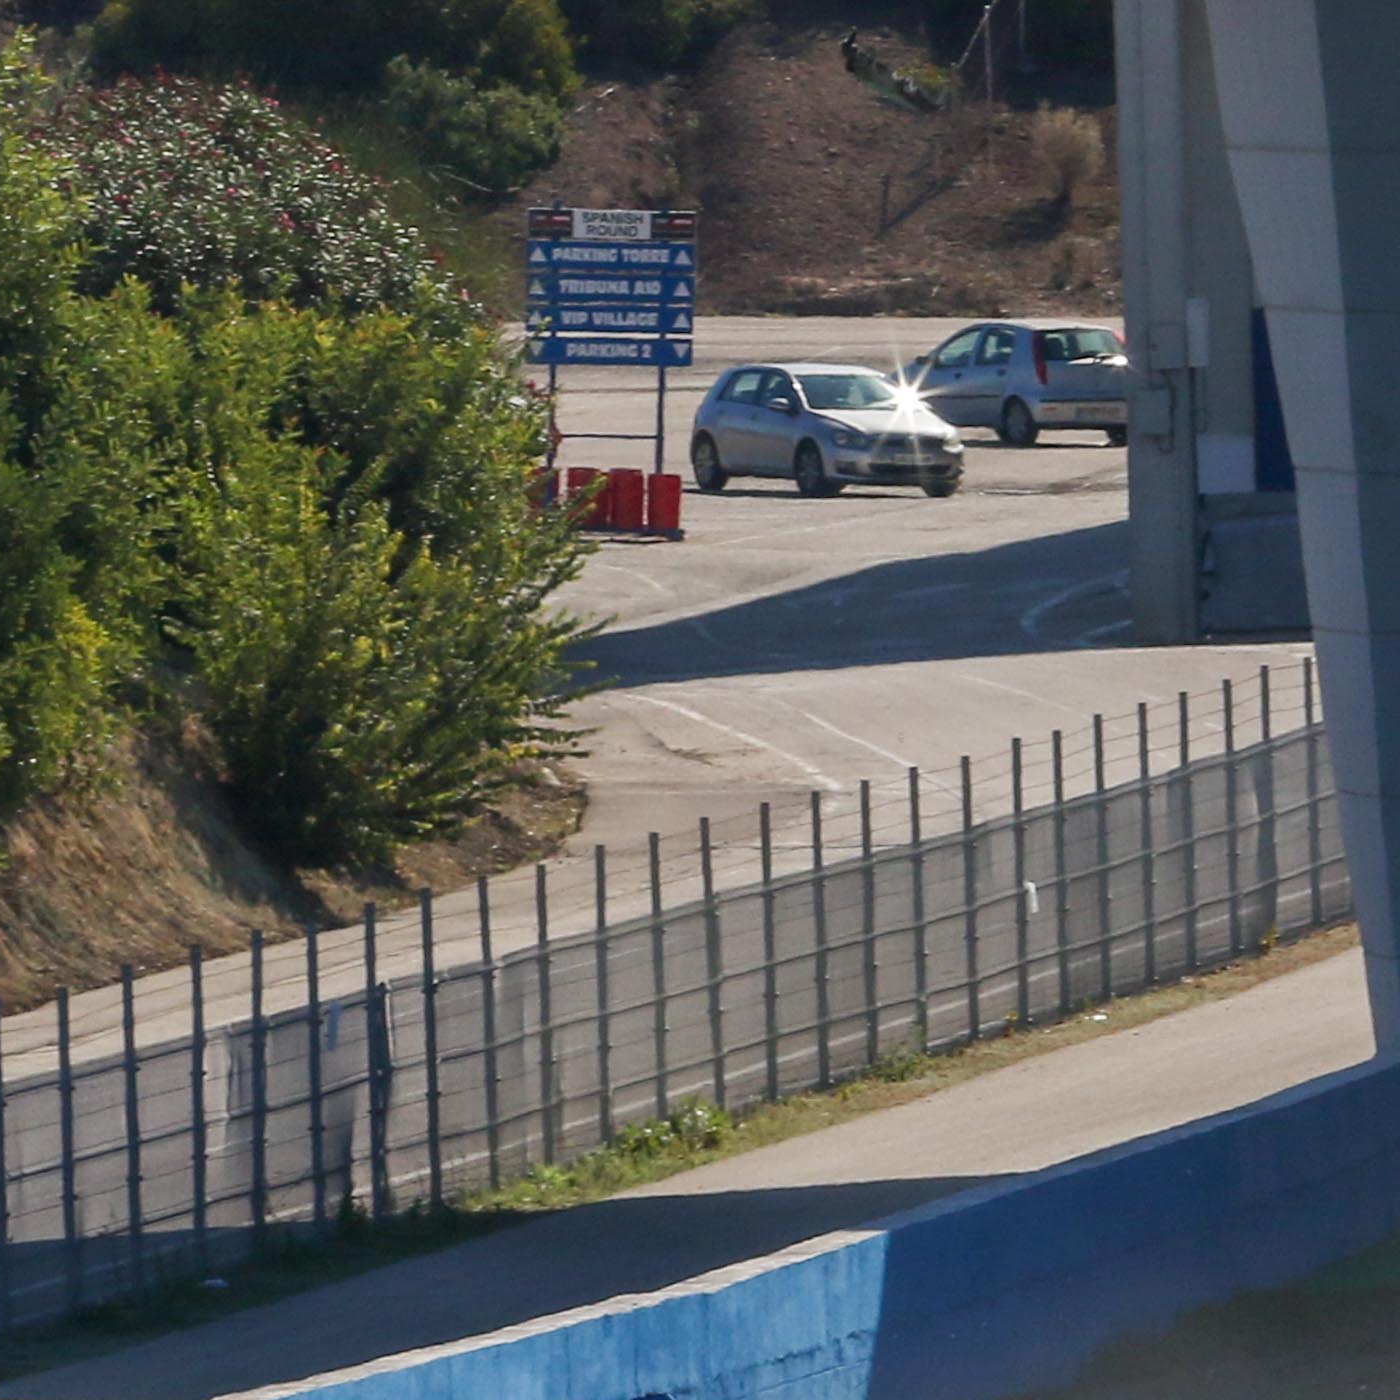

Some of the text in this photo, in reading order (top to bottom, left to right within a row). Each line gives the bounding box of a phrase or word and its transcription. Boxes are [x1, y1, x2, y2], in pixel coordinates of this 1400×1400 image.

[581, 212, 644, 224] SPANISH
[586, 225, 638, 237] ROUND
[552, 248, 670, 263] PARKING TORRE
[558, 279, 629, 294] TRIBUNA
[560, 311, 659, 326] VIP VILLAGE
[566, 343, 652, 358] PARKING 2
